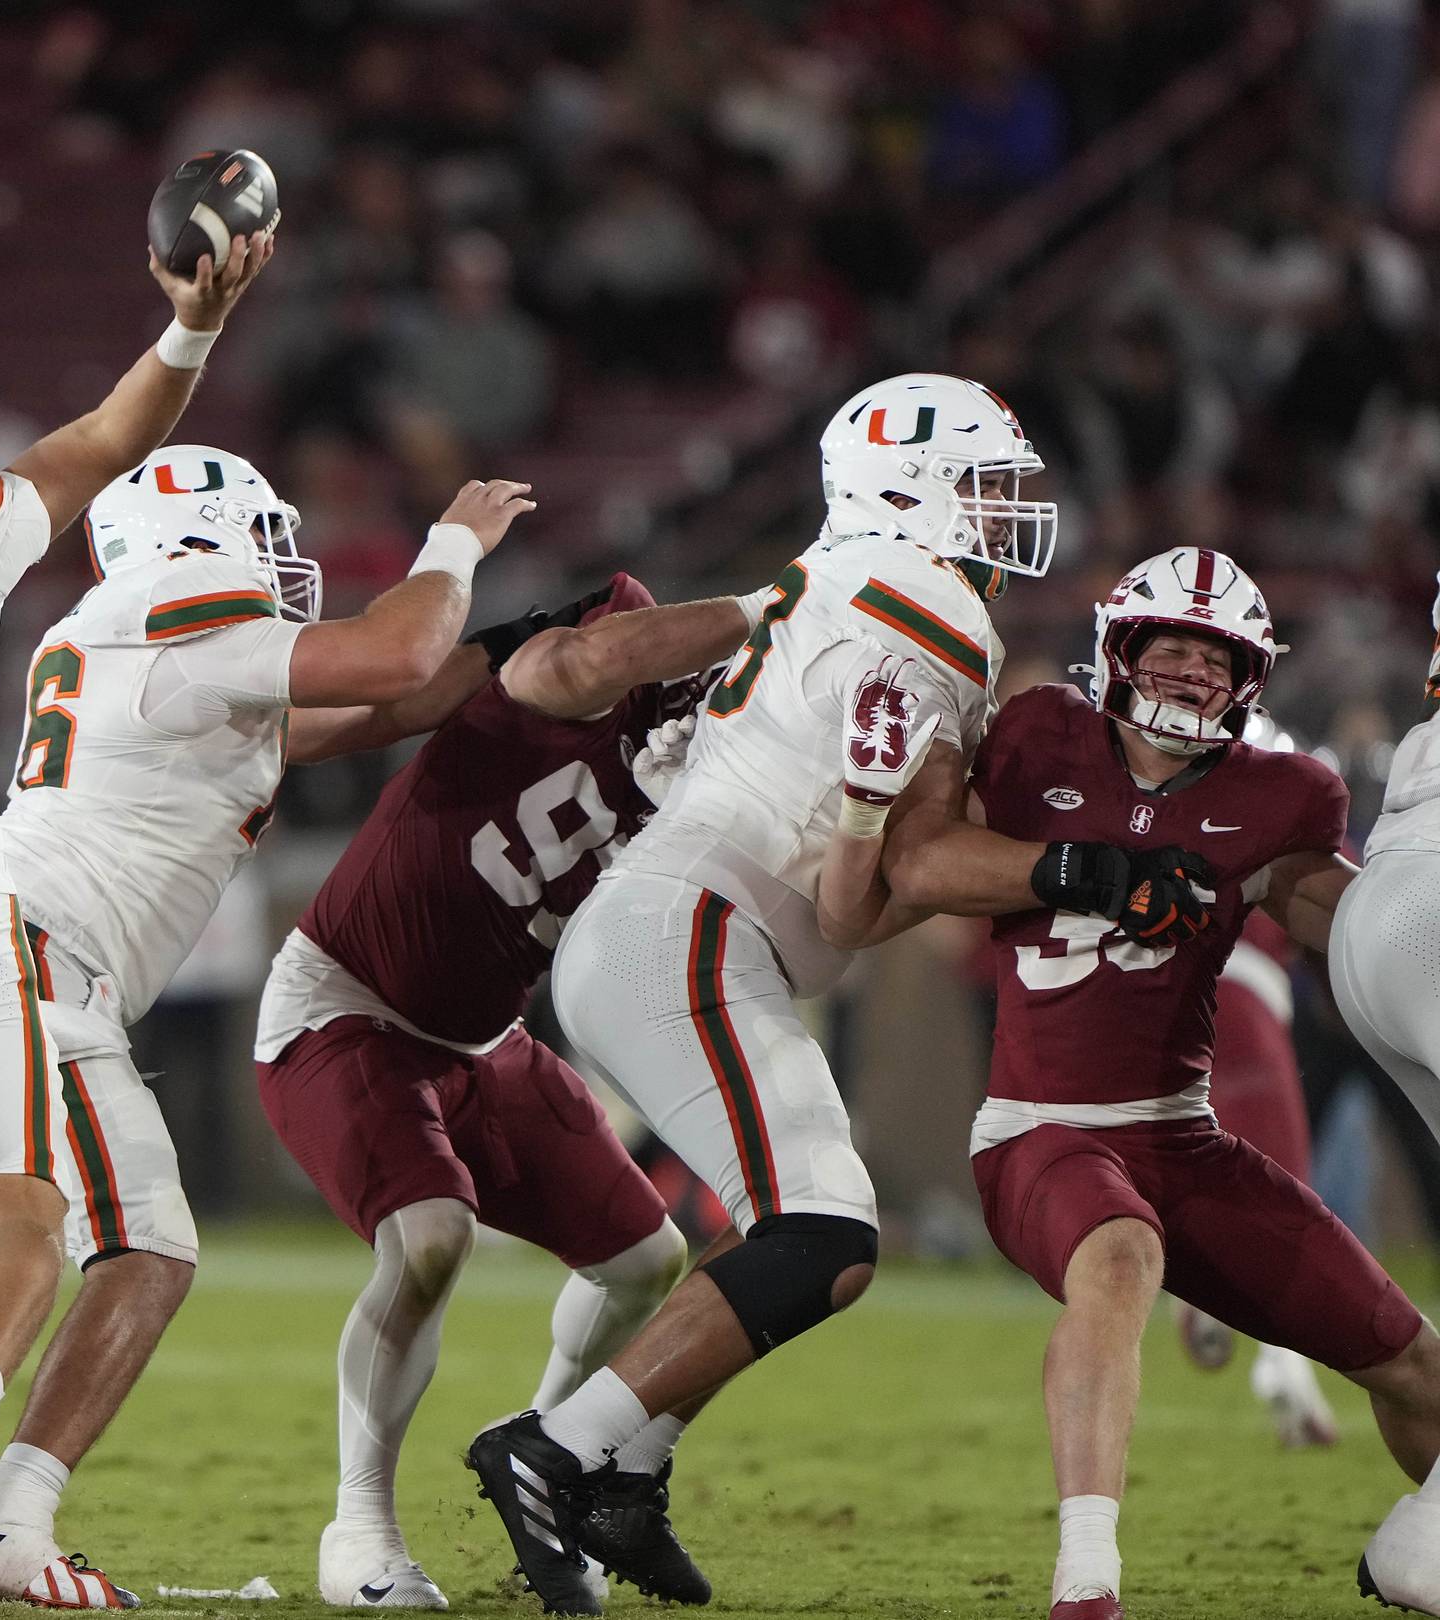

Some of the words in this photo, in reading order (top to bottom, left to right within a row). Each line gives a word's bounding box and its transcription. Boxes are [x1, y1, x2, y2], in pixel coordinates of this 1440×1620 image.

[868, 407, 936, 446] U
[154, 461, 225, 494] U
[1182, 607, 1216, 619] ACC
[1045, 790, 1080, 805] ACC
[471, 759, 628, 950] 9
[1059, 843, 1073, 886] MUELLER
